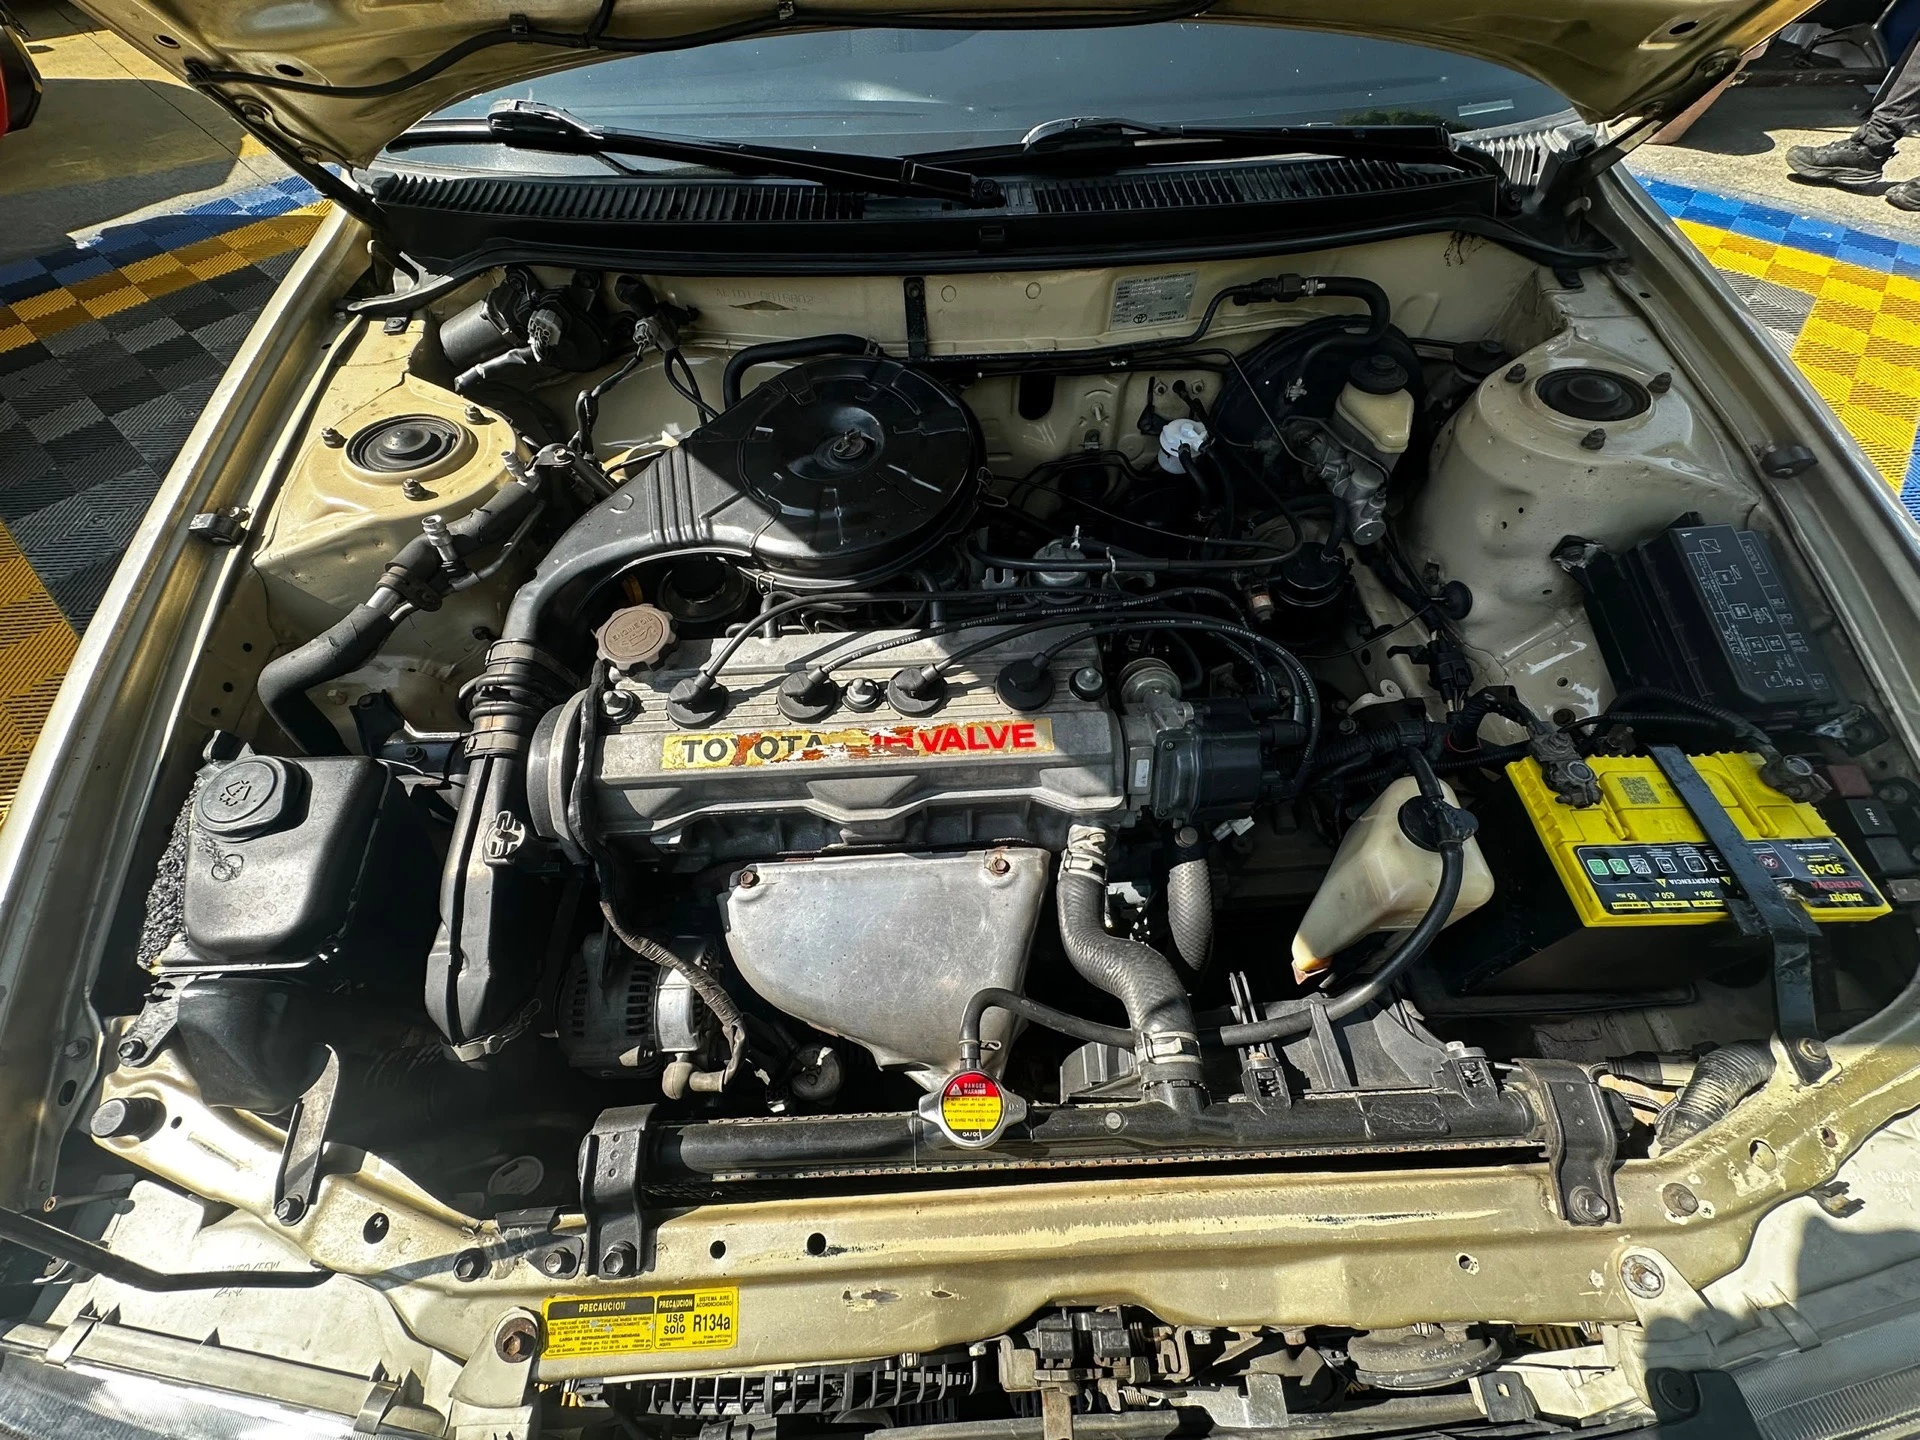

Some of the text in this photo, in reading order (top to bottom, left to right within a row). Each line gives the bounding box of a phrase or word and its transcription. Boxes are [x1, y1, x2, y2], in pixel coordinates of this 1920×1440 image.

[682, 734, 823, 763] TOOTA
[917, 723, 1037, 754] VALVE
[1807, 863, 1846, 875] 9D45
[1668, 877, 1720, 885] ADVERTENCIA
[1627, 892, 1637, 900] 65
[1701, 890, 1715, 898] 306
[1828, 892, 1863, 902] ENERJET
[578, 1300, 627, 1314] PRECAUCION
[658, 1299, 694, 1309] PRECAUCION
[666, 1313, 684, 1324] use
[692, 1313, 731, 1333] R134a
[663, 1322, 686, 1335] solo
